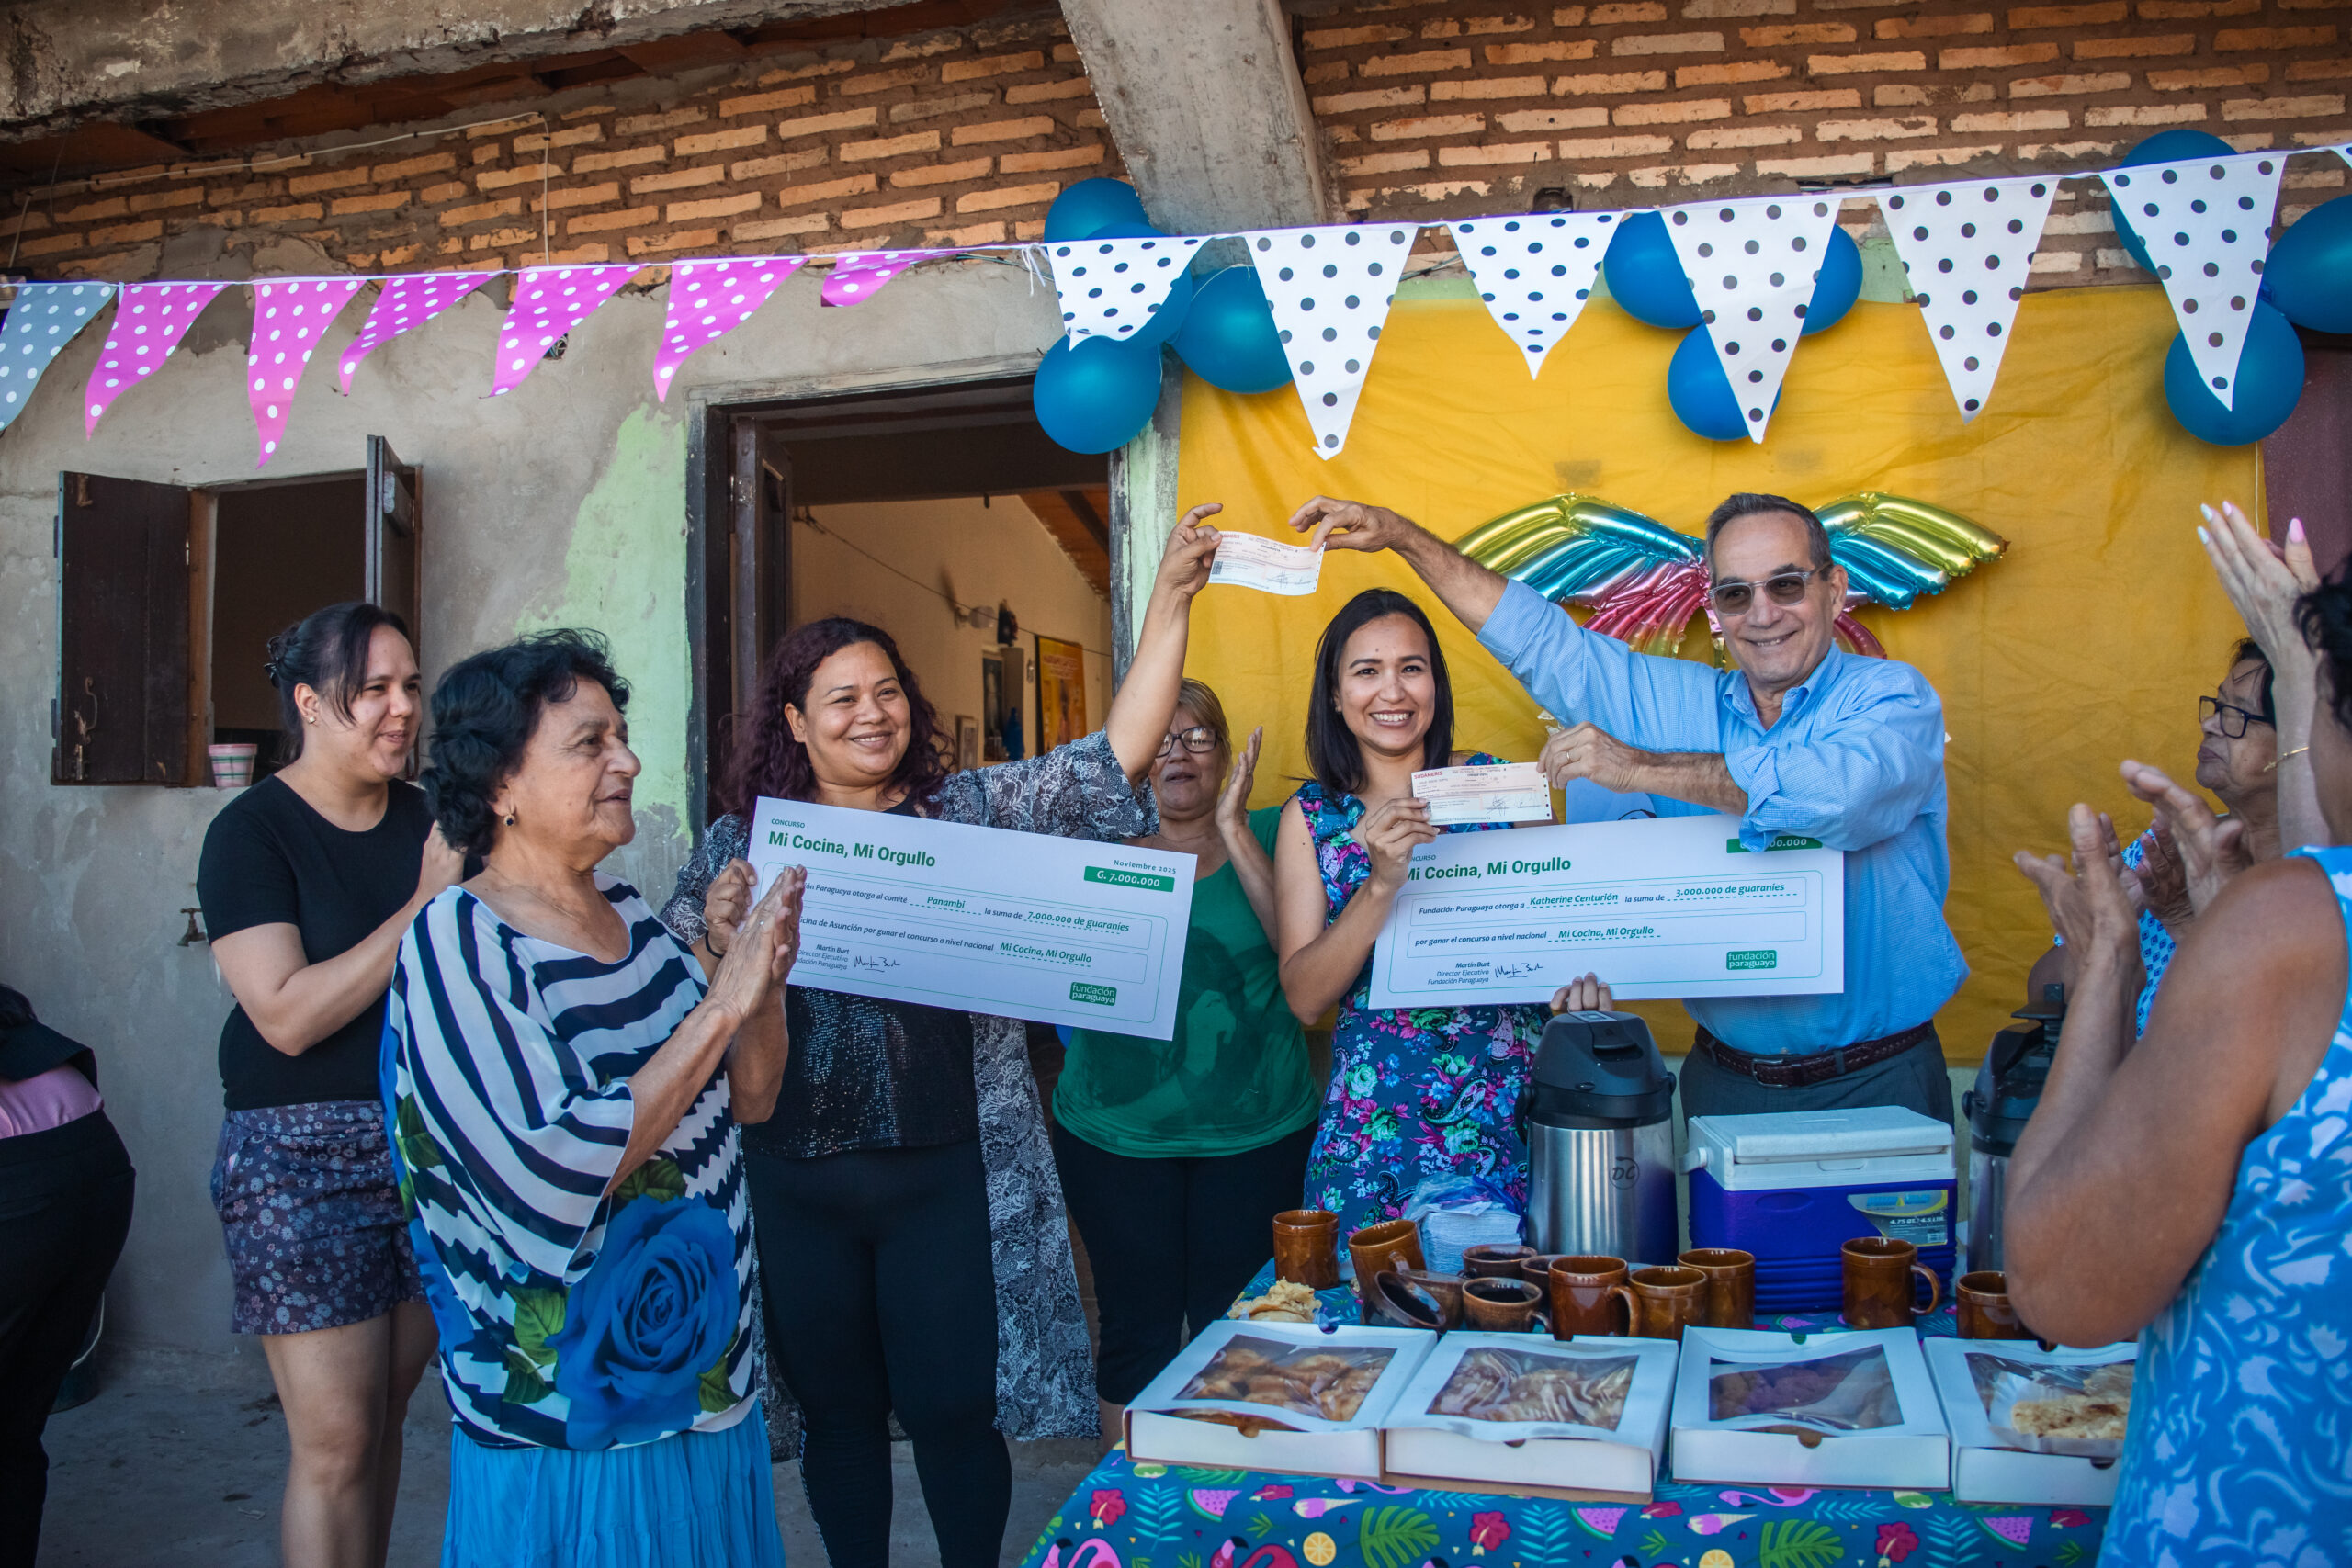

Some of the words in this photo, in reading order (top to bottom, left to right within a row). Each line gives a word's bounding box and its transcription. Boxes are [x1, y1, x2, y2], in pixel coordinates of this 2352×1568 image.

[1414, 771, 1443, 779] SUDAMERIS
[771, 818, 806, 829] CONCURSO
[768, 830, 788, 847] Mi
[792, 834, 848, 859] Cocina,
[854, 842, 874, 859] Mi
[877, 846, 936, 867] Orgullo
[1114, 859, 1156, 871] Noviembre
[1159, 866, 1177, 874] 2025
[1425, 864, 1482, 880] Cocina,
[1487, 861, 1508, 875] Mi
[1512, 857, 1572, 875] Orgullo
[1096, 870, 1107, 880] G.
[1109, 873, 1160, 887] 7.000.000
[815, 883, 851, 896] Paraguaya
[852, 889, 875, 900] otorga
[884, 894, 908, 904] comité
[992, 909, 1012, 918] suma
[1013, 911, 1023, 919] de
[1027, 911, 1072, 924] 7.000.000
[1073, 916, 1086, 925] de
[1419, 905, 1455, 915] Fundación
[1455, 904, 1493, 913] Paraguaya
[1495, 903, 1519, 911] otorga
[1530, 895, 1573, 906] Katherine
[1574, 893, 1619, 903] Centurión
[1676, 886, 1723, 897] 3.000.000
[1724, 885, 1736, 894] de
[799, 916, 818, 925] icina
[829, 920, 863, 932] Asunción
[863, 926, 876, 934] por
[876, 929, 898, 937] ganar
[907, 933, 939, 943] concurso
[945, 938, 963, 947] nivel
[964, 942, 994, 951] nacional
[1000, 942, 1012, 952] Mi
[1013, 944, 1044, 957] Cocina,
[1046, 949, 1058, 958] Mi
[1059, 951, 1092, 963] Orgullo
[1415, 939, 1427, 947] por
[1428, 938, 1449, 947] ganar
[1451, 935, 1458, 943] el
[1516, 931, 1547, 940] nacional
[1558, 929, 1570, 938] Mi
[1572, 927, 1604, 938] Cocina,
[1606, 927, 1619, 936] Mi
[1620, 926, 1654, 938] Orgullo
[821, 953, 848, 963] Ejecutivo
[1728, 951, 1775, 961] fundación
[818, 960, 847, 971] Paraguaya
[1728, 960, 1775, 969] paraguaya
[1437, 969, 1461, 977] Director
[1428, 977, 1457, 986] Fundación
[1458, 976, 1489, 985] Paraguaya
[1072, 983, 1114, 997] fundación
[1071, 992, 1114, 1004] paraguaya
[1612, 1165, 1635, 1180] DC
